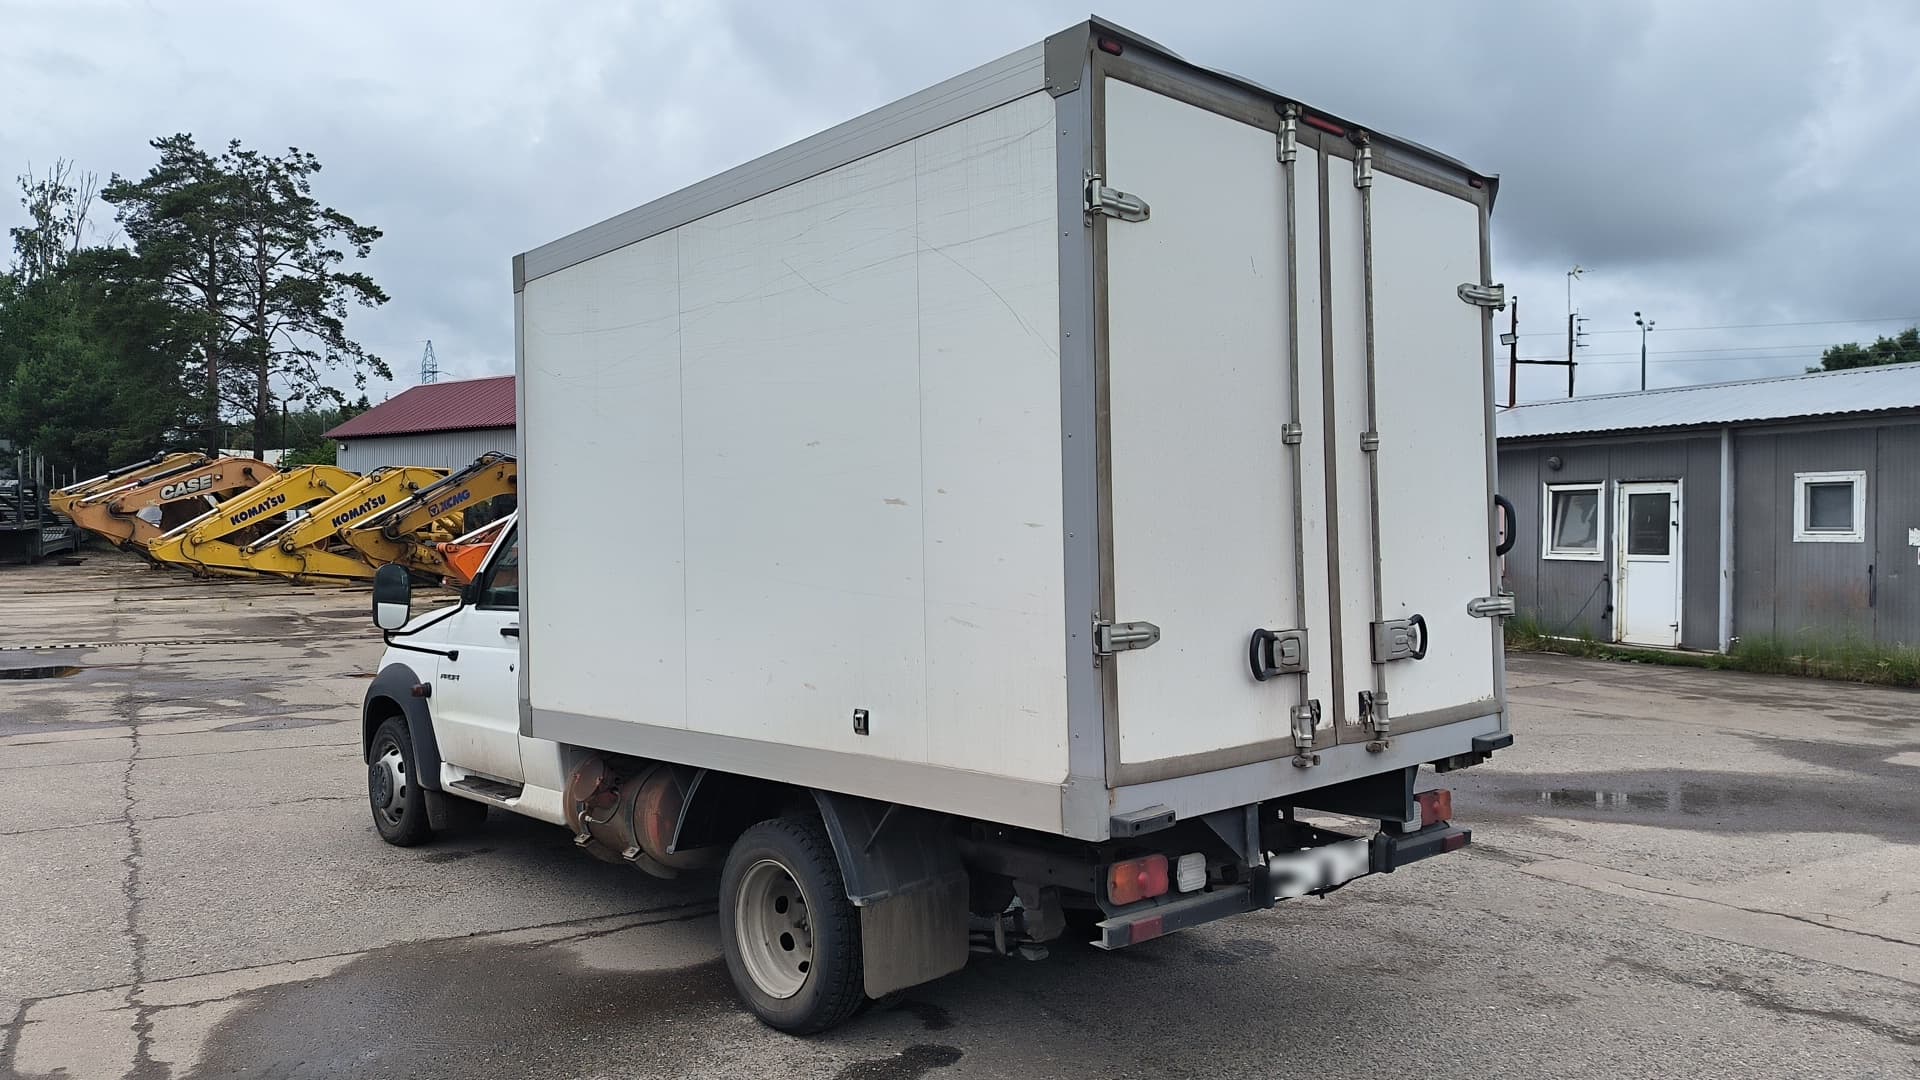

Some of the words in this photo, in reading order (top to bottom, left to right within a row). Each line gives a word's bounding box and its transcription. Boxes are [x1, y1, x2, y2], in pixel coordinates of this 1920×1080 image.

[160, 474, 212, 500] CASE
[230, 493, 286, 525] KOMATSU
[331, 494, 386, 528] KOMATSU
